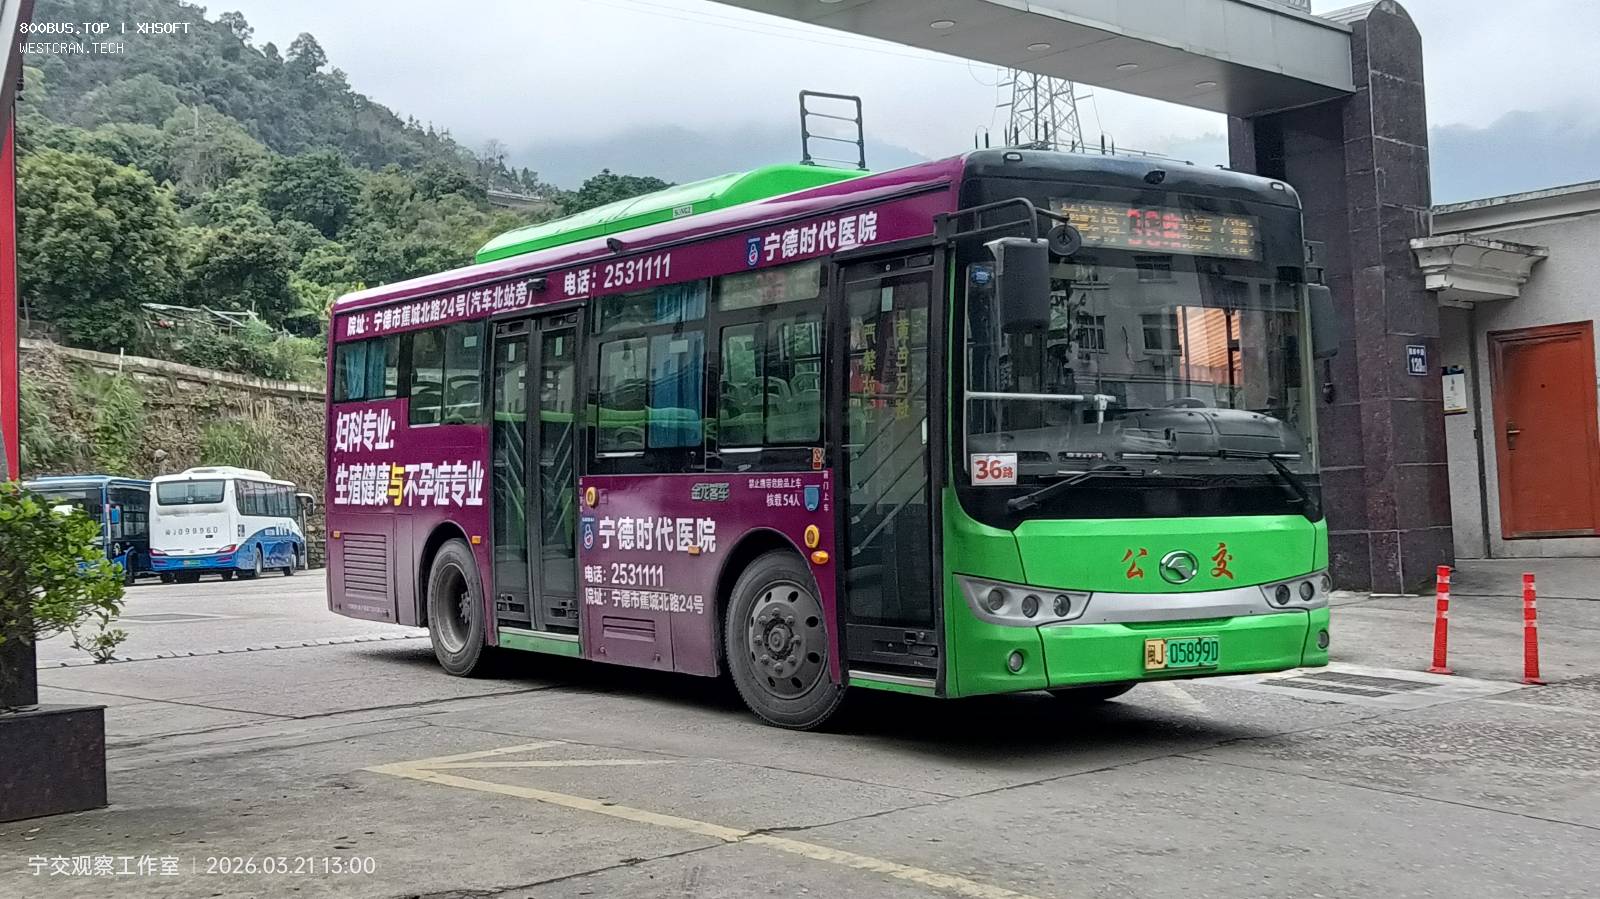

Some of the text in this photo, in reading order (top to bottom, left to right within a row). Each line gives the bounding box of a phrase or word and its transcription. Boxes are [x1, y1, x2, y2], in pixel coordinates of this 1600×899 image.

[763, 210, 878, 262] 宁德时代医院
[334, 408, 396, 453] 妇科专业:
[334, 459, 485, 508] 生殖健康与不孕症专业
[748, 477, 802, 489] 禁止携带危险品上车
[975, 459, 1014, 480] 36路
[691, 482, 730, 501] 金龙客车
[599, 515, 716, 554] 宁德时代医院
